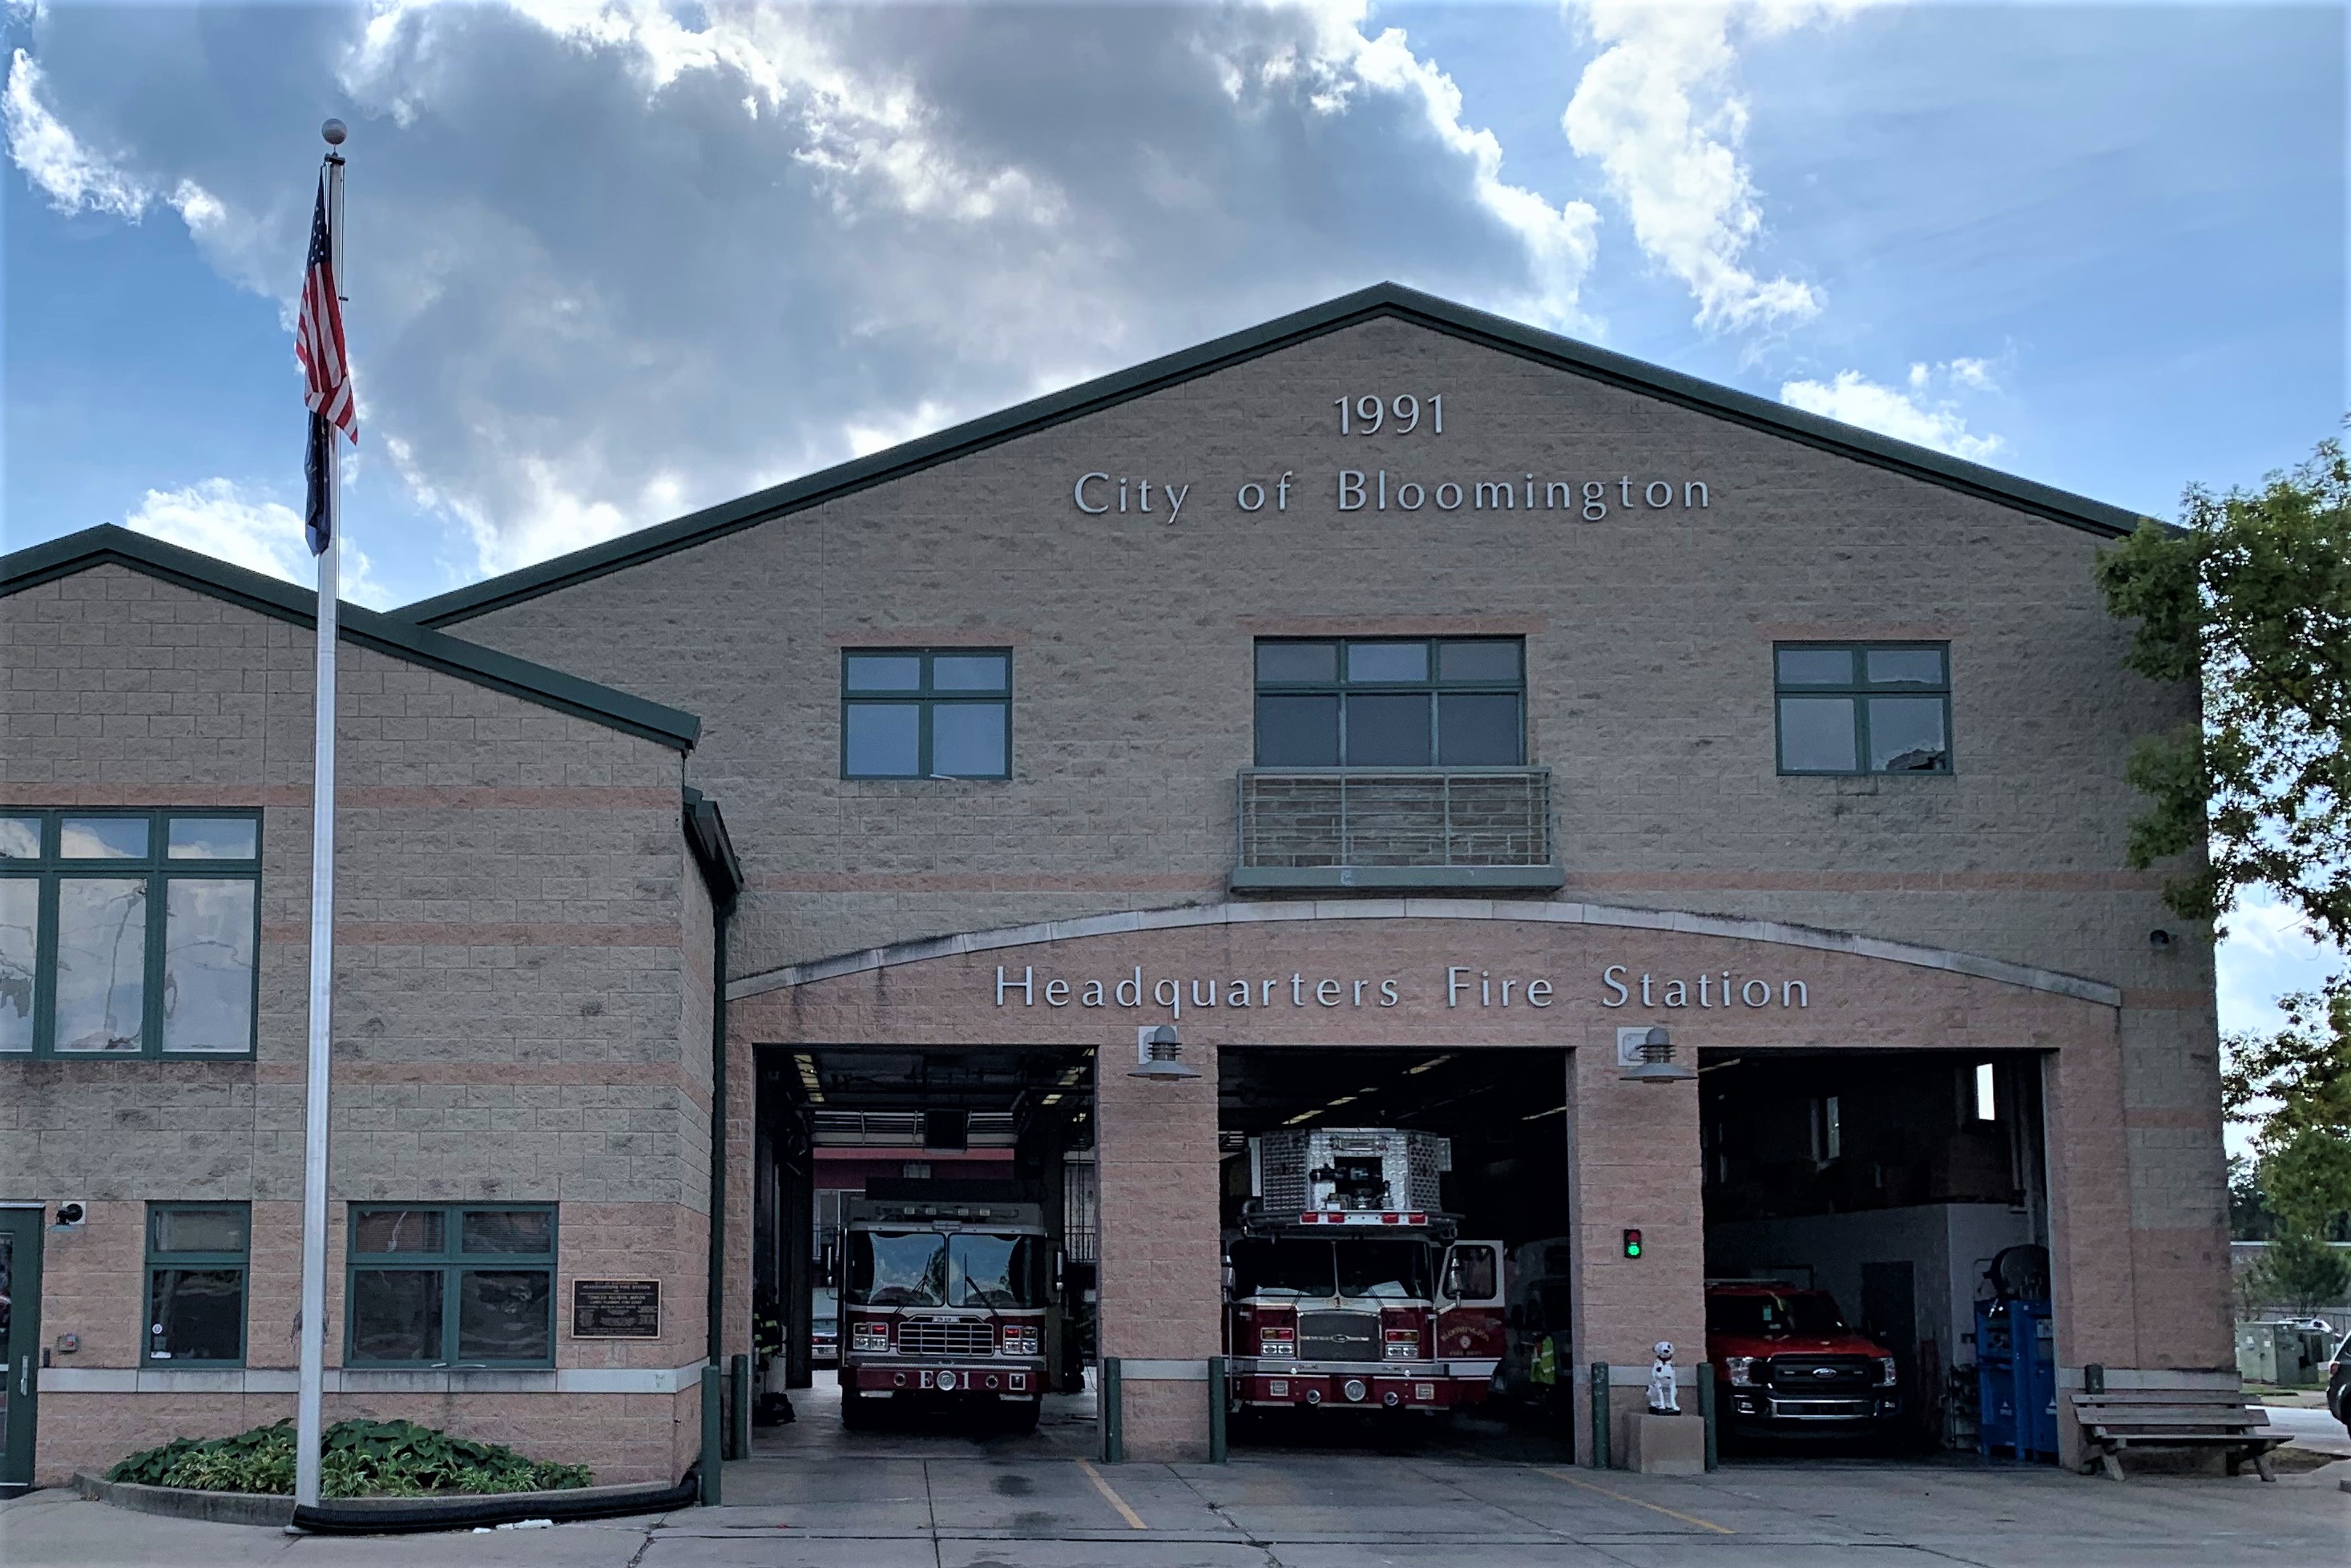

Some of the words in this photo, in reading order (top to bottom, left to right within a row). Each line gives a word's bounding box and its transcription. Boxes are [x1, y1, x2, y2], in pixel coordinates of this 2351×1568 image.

[1334, 394, 1444, 436] 1991
[1074, 472, 1190, 525] City
[1236, 470, 1293, 511] of
[1337, 470, 1710, 522] Bloomington
[995, 965, 1399, 1020] Headquarters
[1446, 965, 1554, 1008] Fire
[1602, 964, 1809, 1008] Station
[1333, 1296, 1341, 1308] 1
[917, 1369, 934, 1389] E
[962, 1371, 971, 1390] 1
